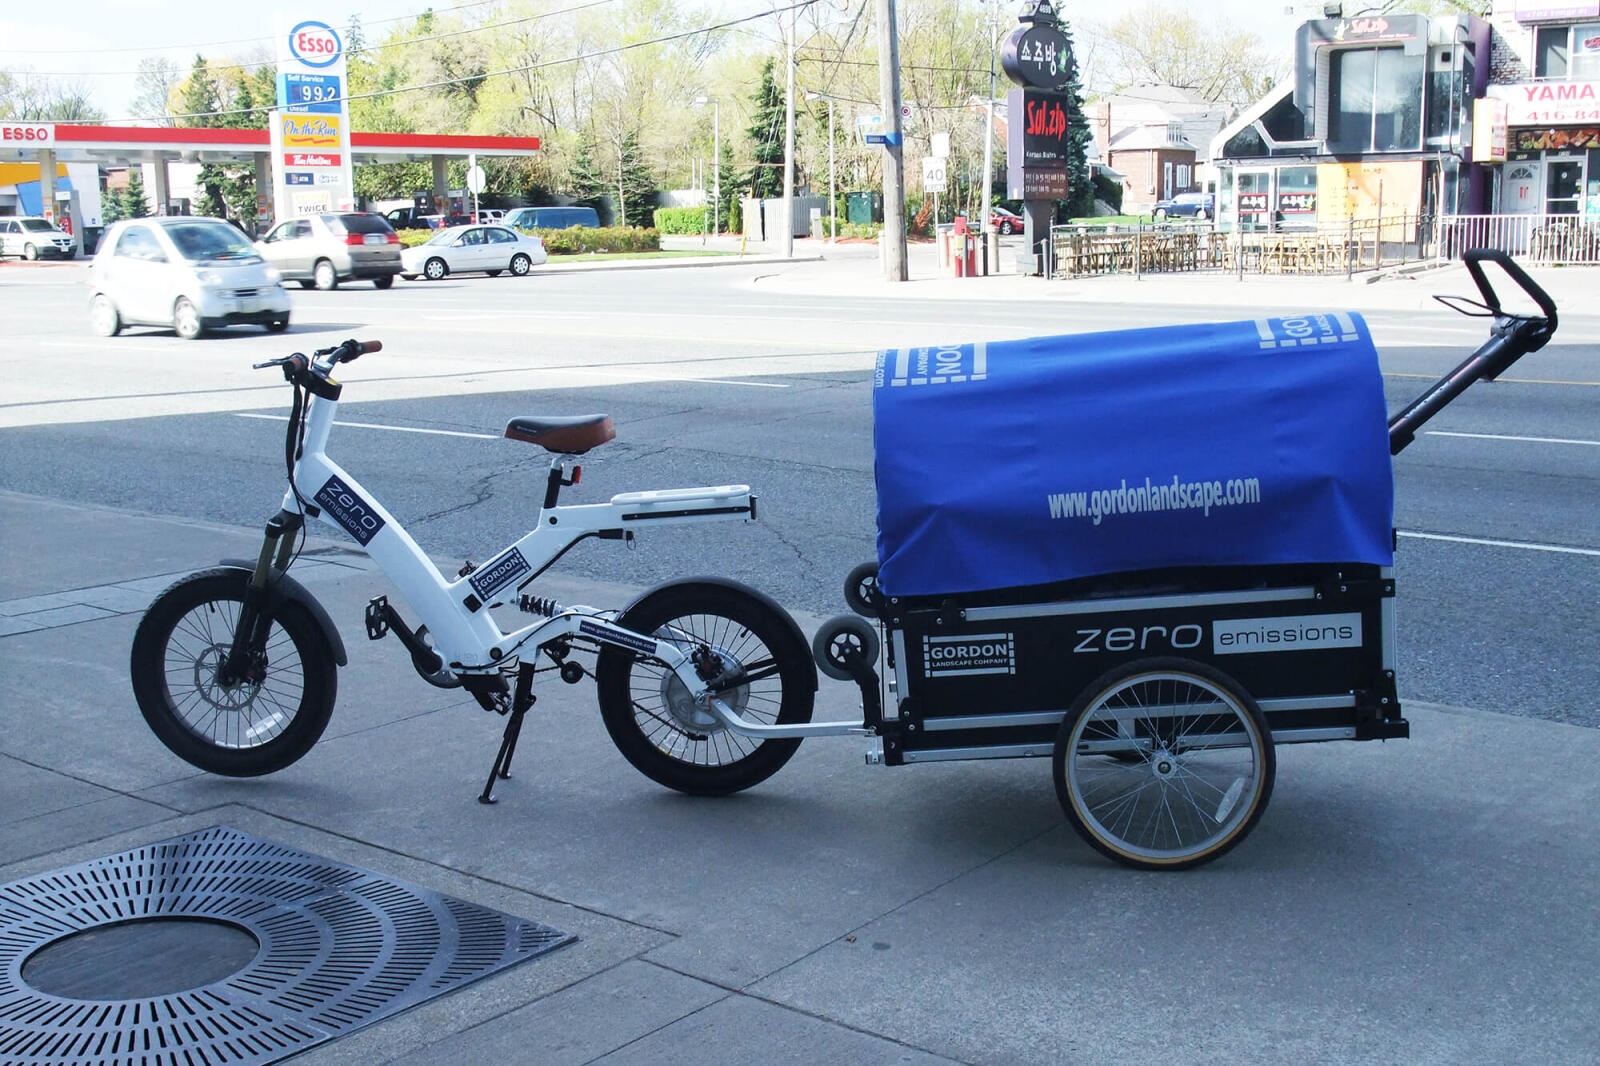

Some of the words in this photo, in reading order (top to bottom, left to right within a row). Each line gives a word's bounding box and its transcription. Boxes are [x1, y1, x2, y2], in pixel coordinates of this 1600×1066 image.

[1021, 40, 1056, 76] 소주방
[302, 85, 336, 101] 99.2
[3, 127, 48, 141] ESSO
[926, 168, 944, 181] 40
[326, 482, 377, 530] zero
[1048, 475, 1261, 526] www.gordonlandscape.com
[319, 492, 367, 539] emissions
[480, 556, 519, 587] GORDON
[931, 643, 1007, 659] GORDON
[1073, 624, 1203, 653] zero
[1219, 624, 1353, 646] emissions
[932, 659, 972, 668] LANDSCAPE
